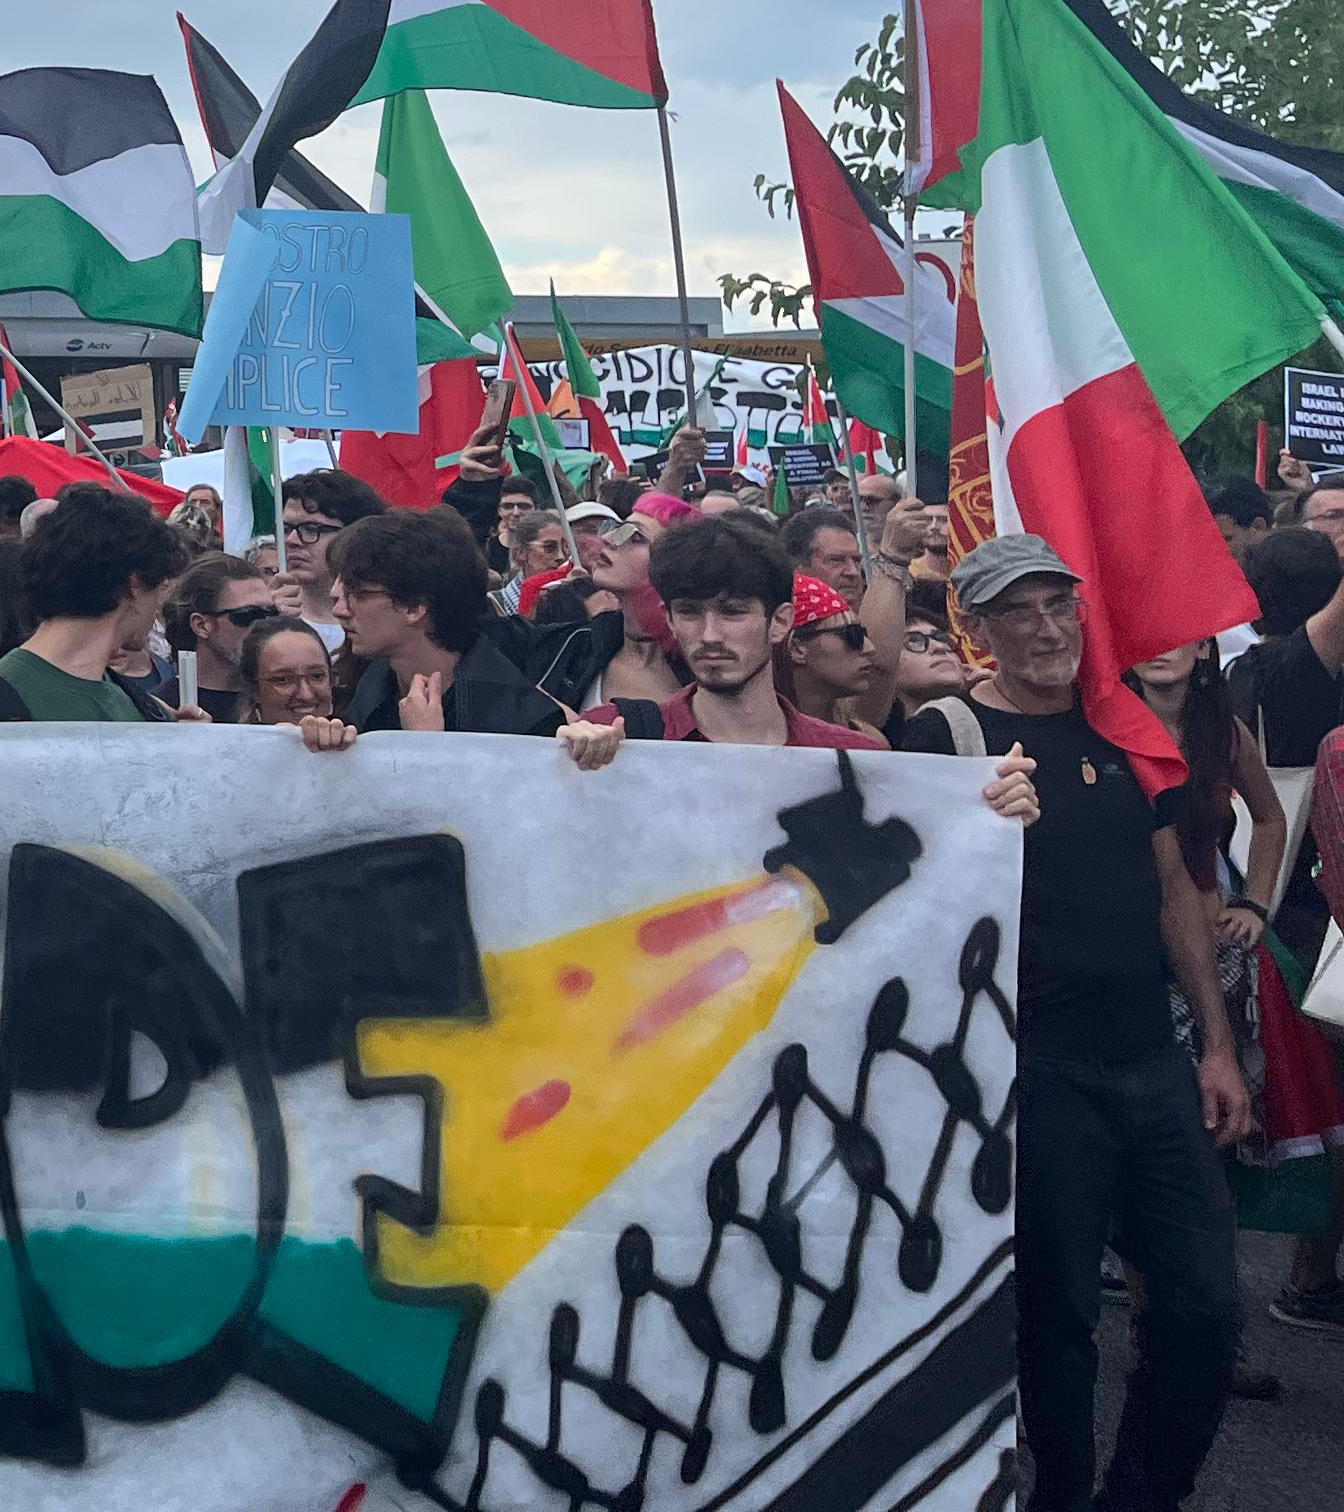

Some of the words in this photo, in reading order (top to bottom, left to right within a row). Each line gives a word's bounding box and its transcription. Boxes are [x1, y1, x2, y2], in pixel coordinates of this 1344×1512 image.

[258, 223, 369, 275] OSTRO
[243, 280, 356, 354] NZIO
[87, 341, 113, 351] Actv
[1301, 382, 1338, 398] ISRAEL
